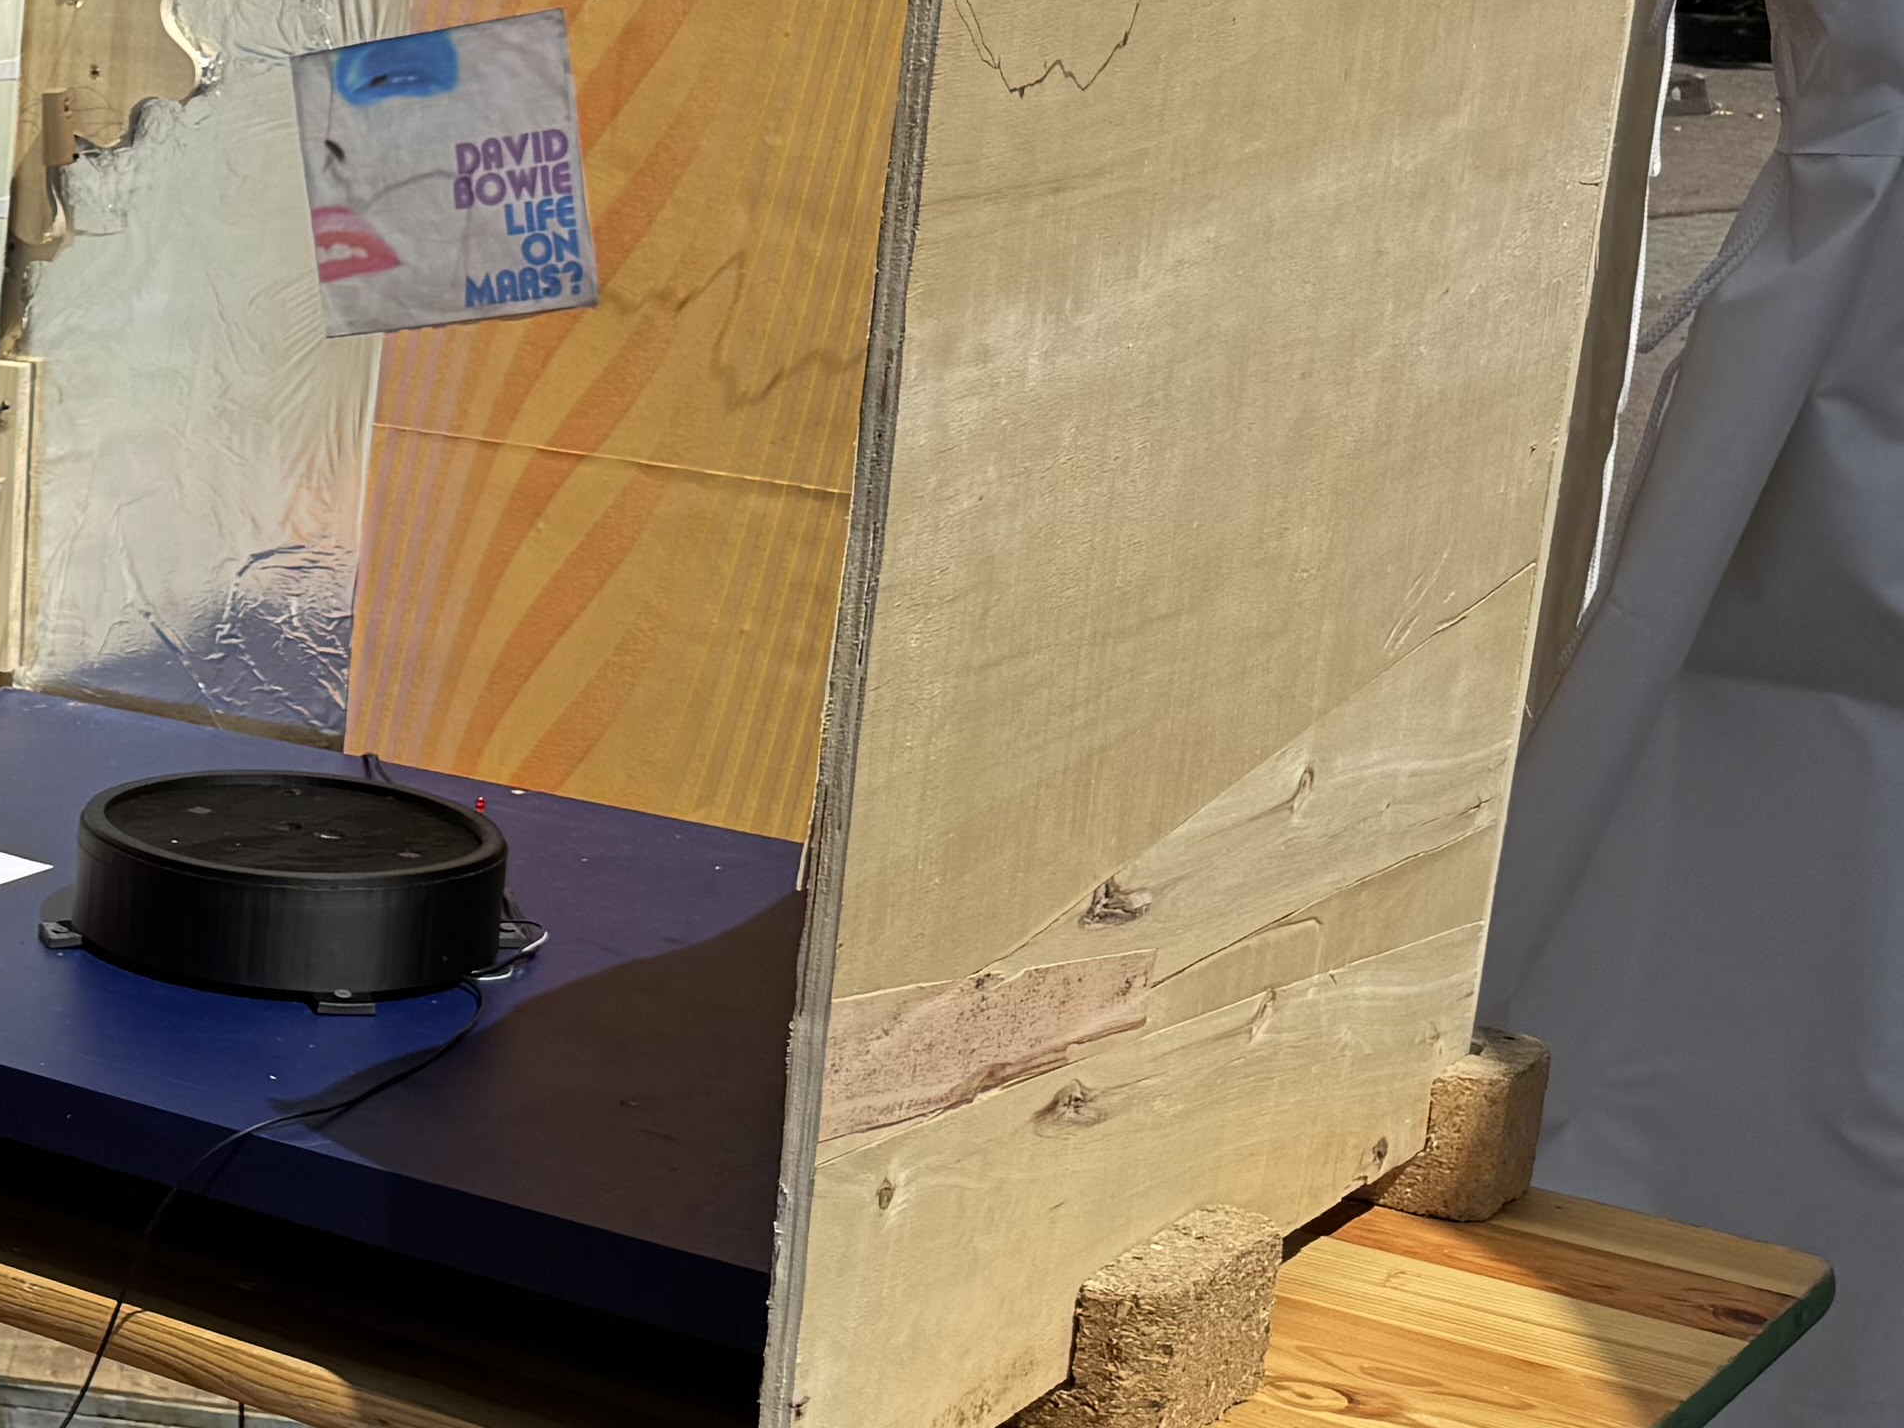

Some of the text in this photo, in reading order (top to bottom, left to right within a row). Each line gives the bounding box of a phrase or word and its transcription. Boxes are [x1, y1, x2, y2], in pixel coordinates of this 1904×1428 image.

[455, 128, 569, 175] DAVID
[453, 161, 573, 210] BOWIE
[505, 195, 577, 236] LIFE
[521, 229, 580, 266] ON
